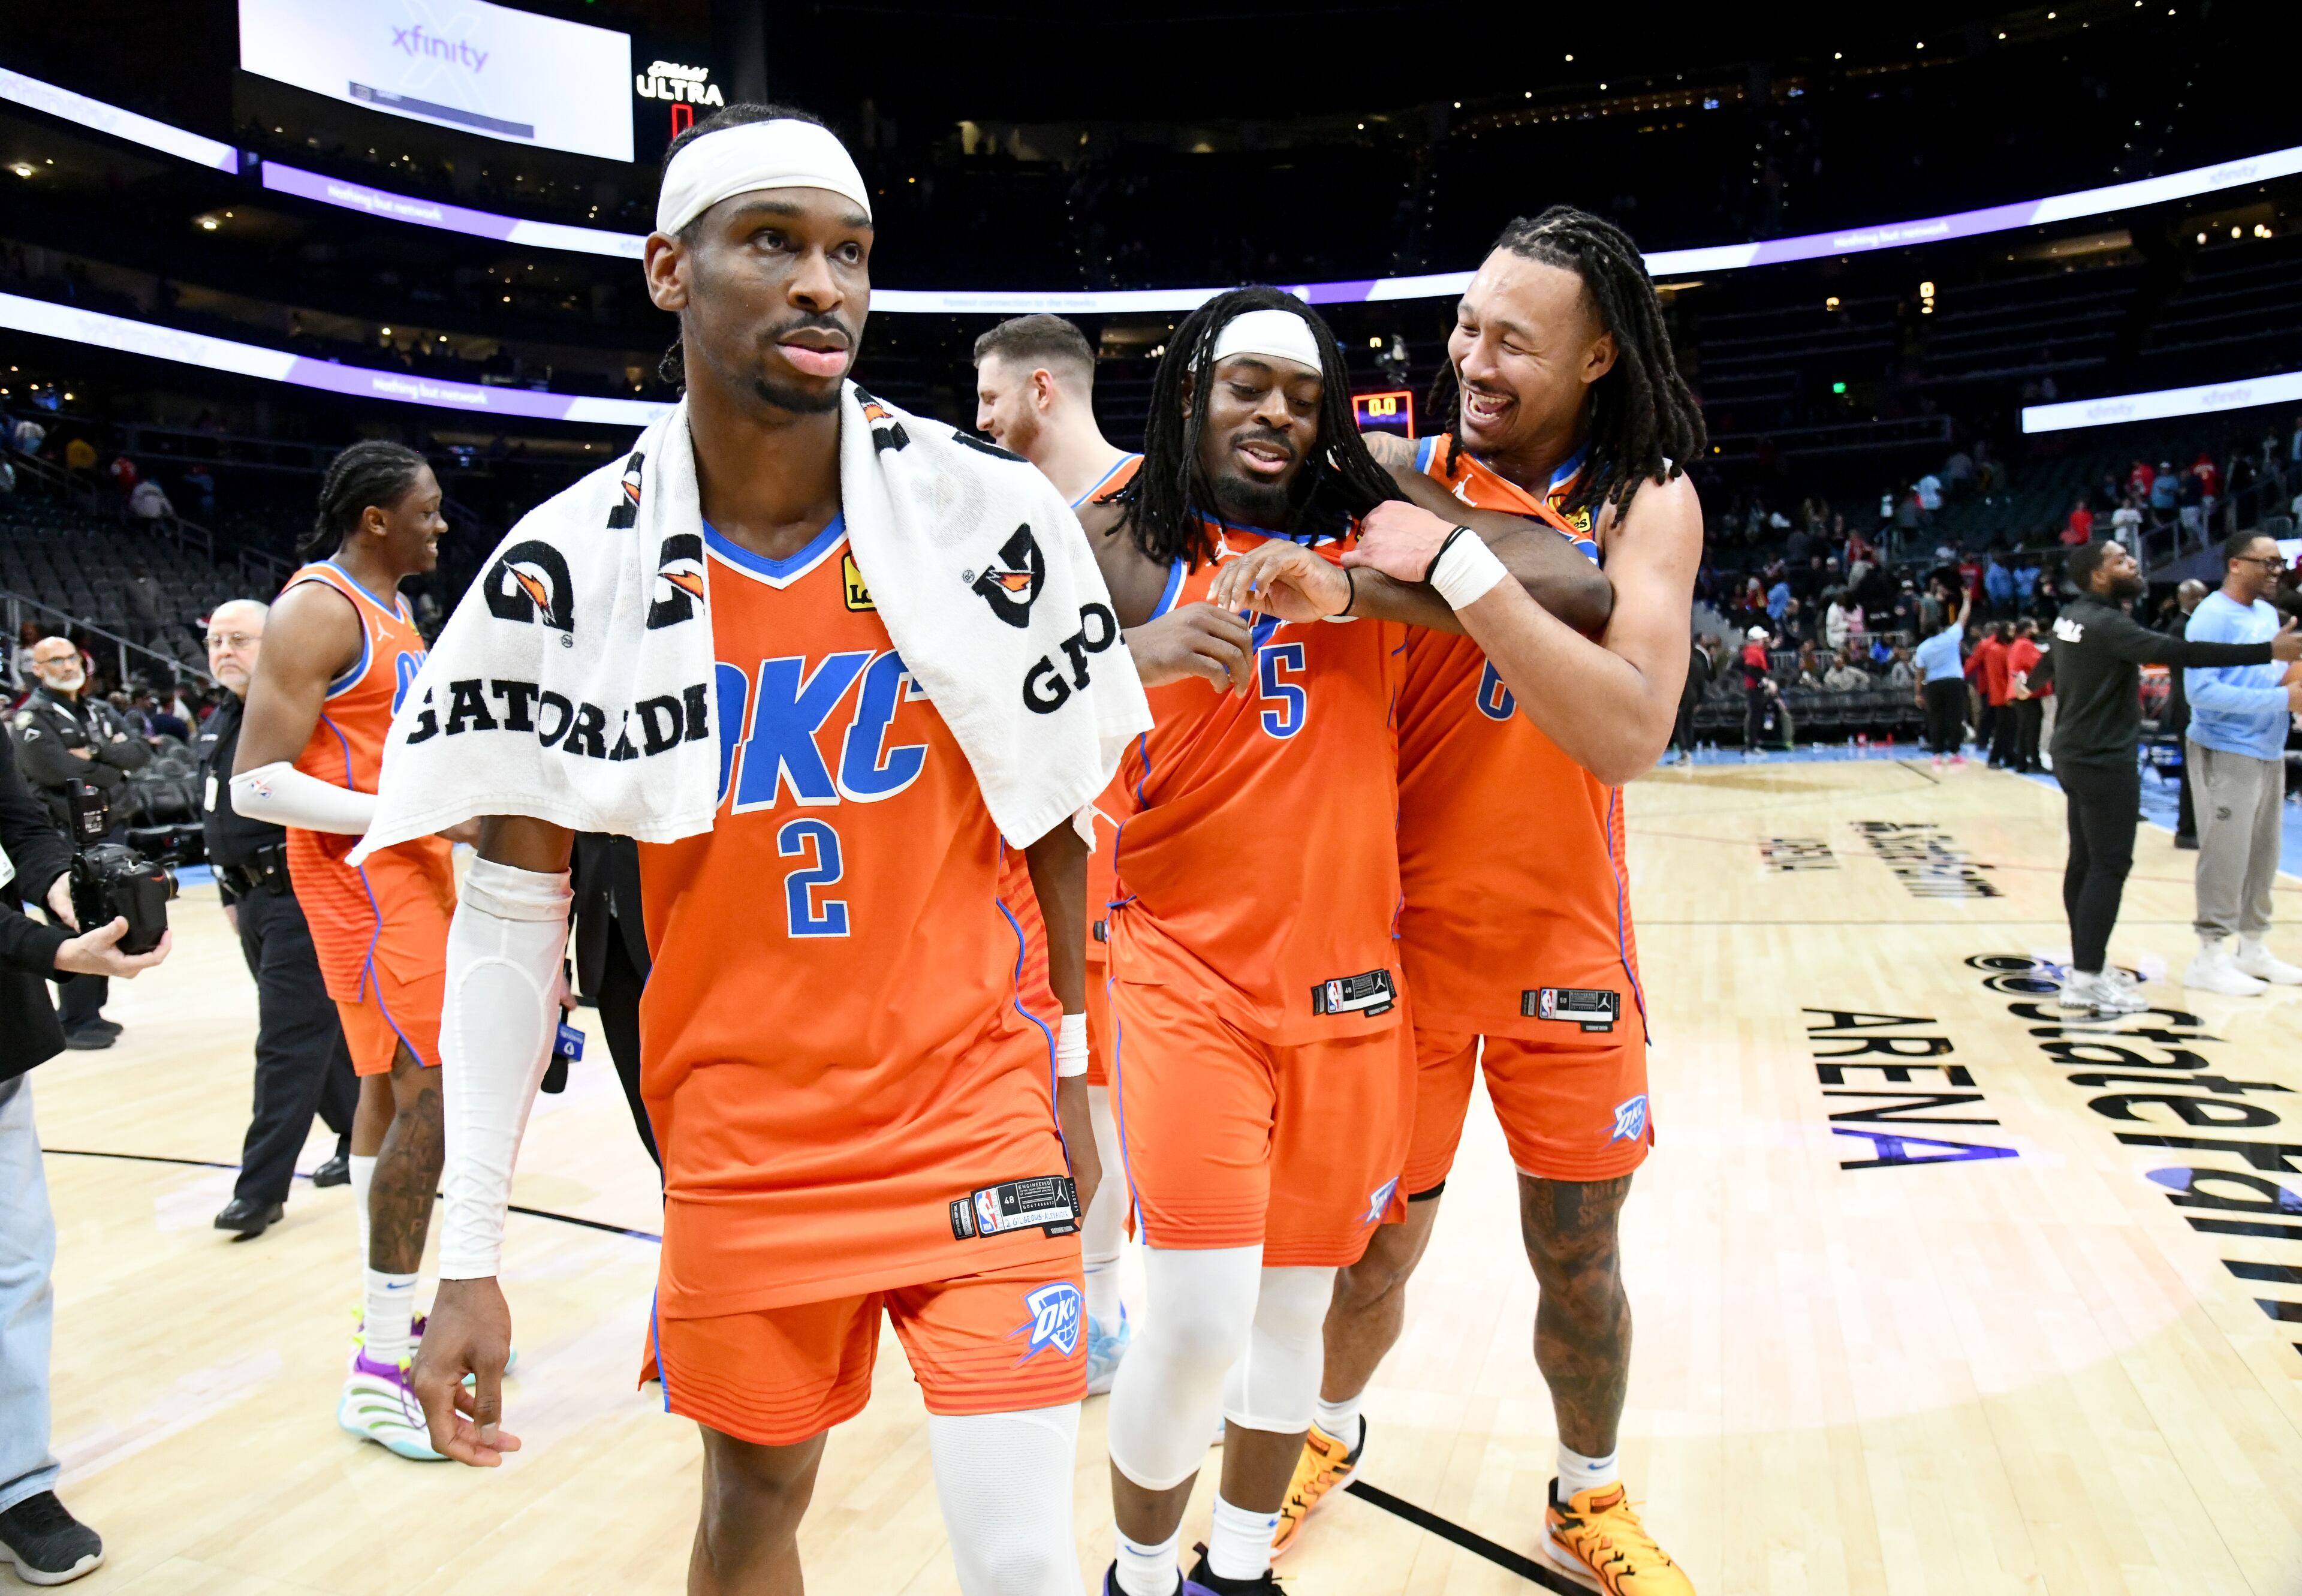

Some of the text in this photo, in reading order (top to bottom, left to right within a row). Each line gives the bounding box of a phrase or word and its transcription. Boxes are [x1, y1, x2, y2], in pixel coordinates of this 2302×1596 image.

[392, 25, 489, 73] xfinity
[637, 74, 724, 107] ULTRA
[1369, 398, 1396, 417] 0.0
[1257, 642, 1307, 740] 5
[776, 818, 850, 938] 2
[1801, 1007, 2020, 1170] ARENA
[1004, 1196, 1015, 1204] 48
[1018, 1181, 1050, 1190] ENGINEERED
[1005, 1219, 1012, 1228] 2
[1031, 1295, 1077, 1345] OKC
